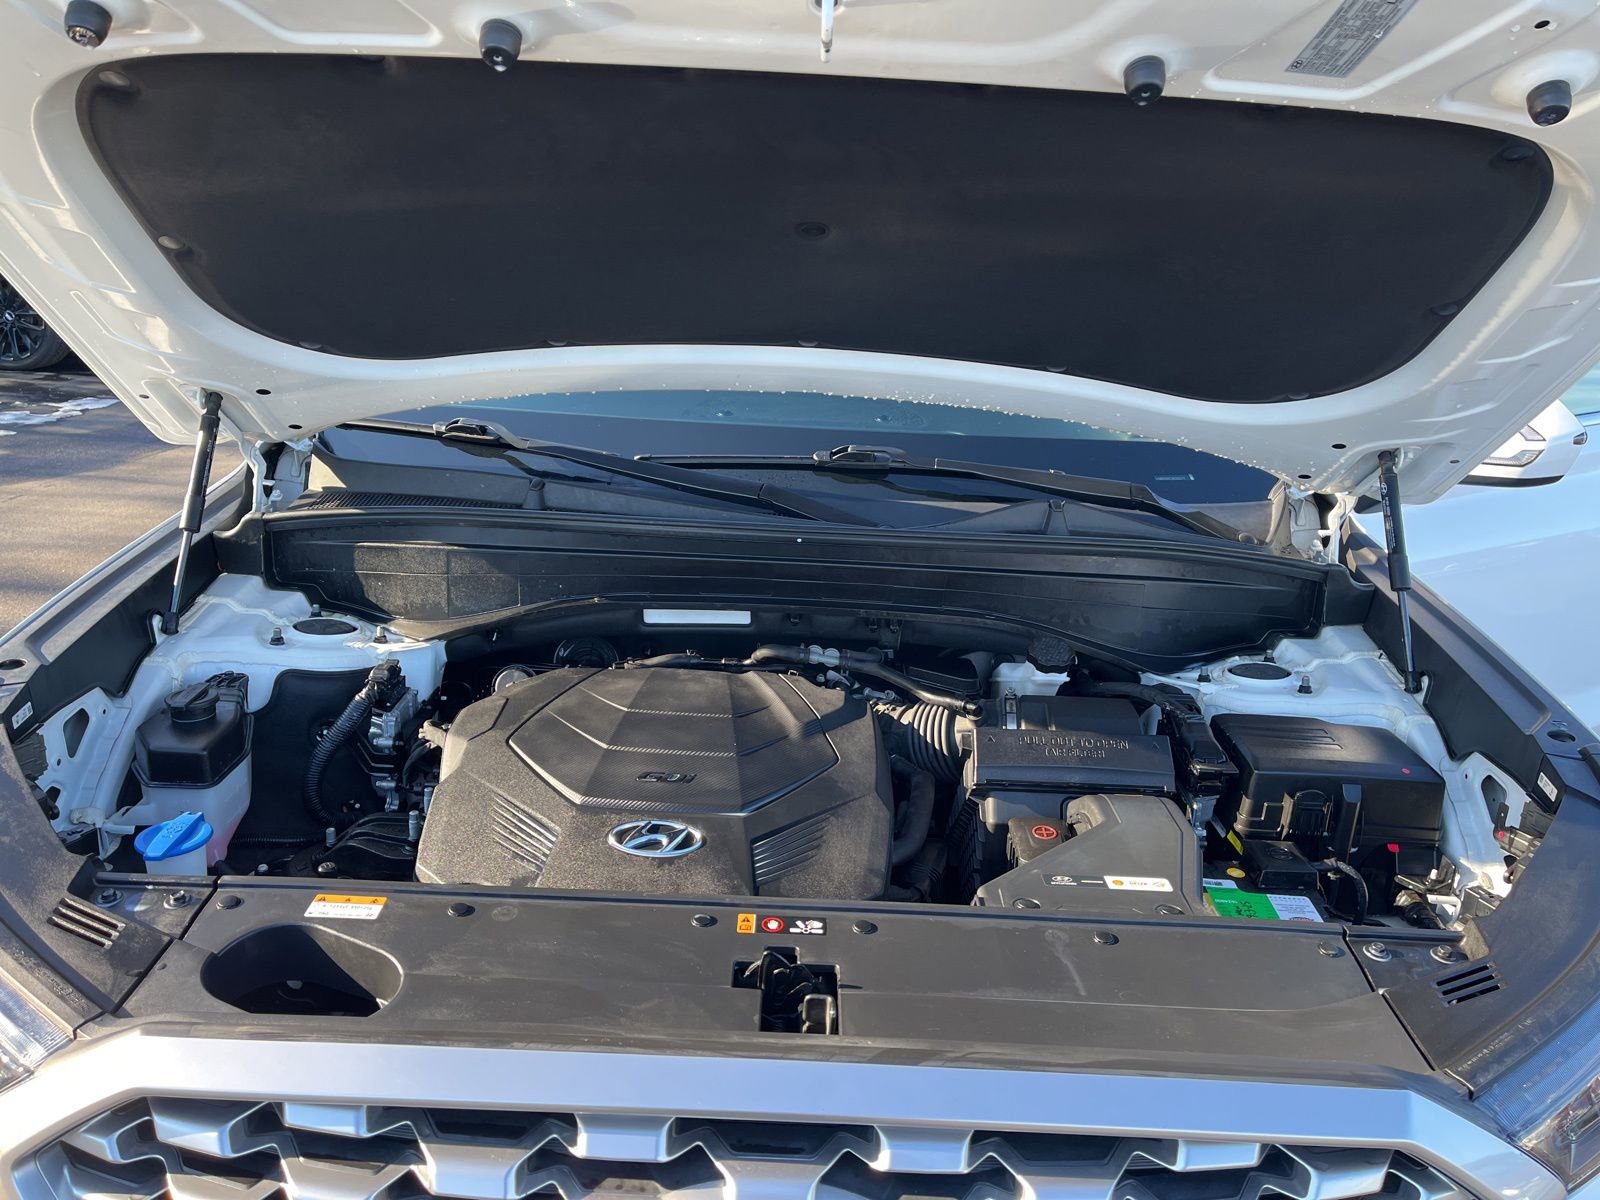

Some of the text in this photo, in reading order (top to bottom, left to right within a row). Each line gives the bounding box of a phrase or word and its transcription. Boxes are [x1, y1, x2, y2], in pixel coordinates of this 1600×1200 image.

[1019, 736, 1129, 749] PULL OUT TO OPEN
